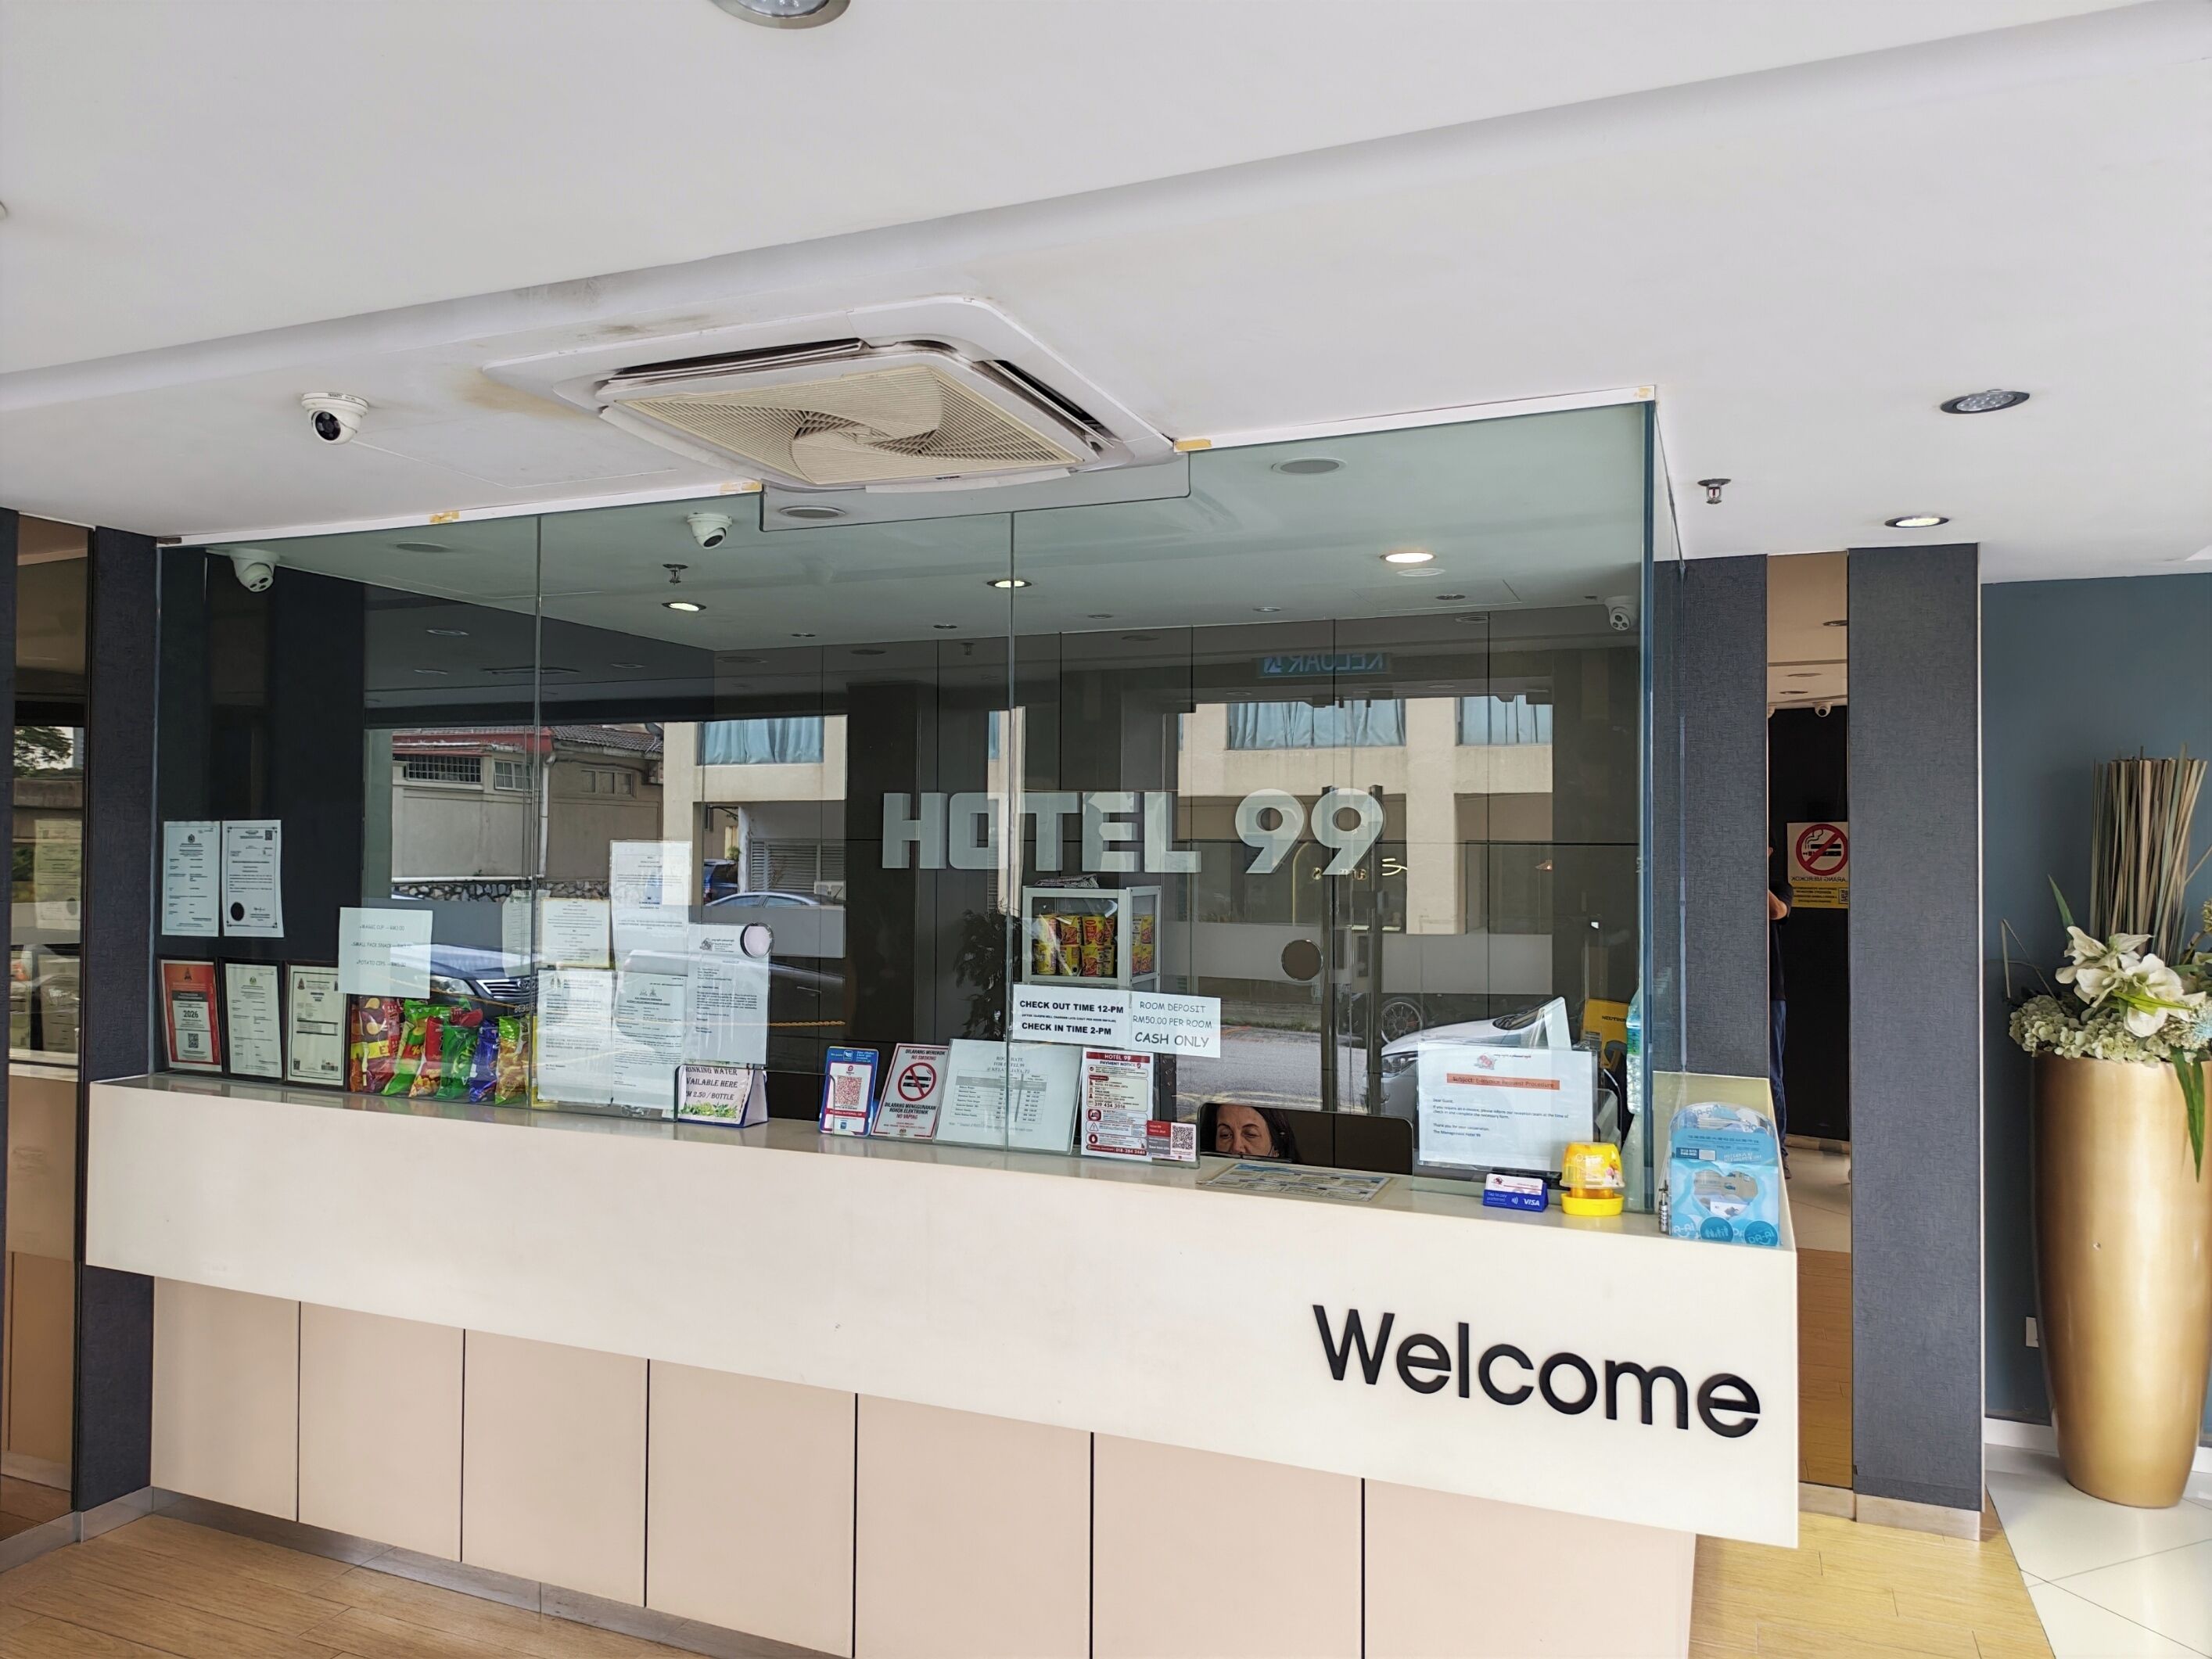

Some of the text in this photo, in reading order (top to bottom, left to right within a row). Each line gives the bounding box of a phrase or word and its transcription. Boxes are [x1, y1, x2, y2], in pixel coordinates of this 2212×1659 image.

[882, 788, 1384, 874] HOTEL 99
[183, 1010, 199, 1018] 2026
[1020, 1000, 1050, 1009] CHECK
[1097, 1005, 1124, 1014] 12-PM
[1140, 1001, 1206, 1013] ROOM DEPOSIT
[1022, 1022, 1051, 1031] CHECK
[1133, 1015, 1212, 1029] RM50.00 PER ROOM
[1135, 1032, 1209, 1048] CASH ONLY
[686, 1077, 719, 1086] VAILABLE
[1312, 1304, 1761, 1438] Welcome
